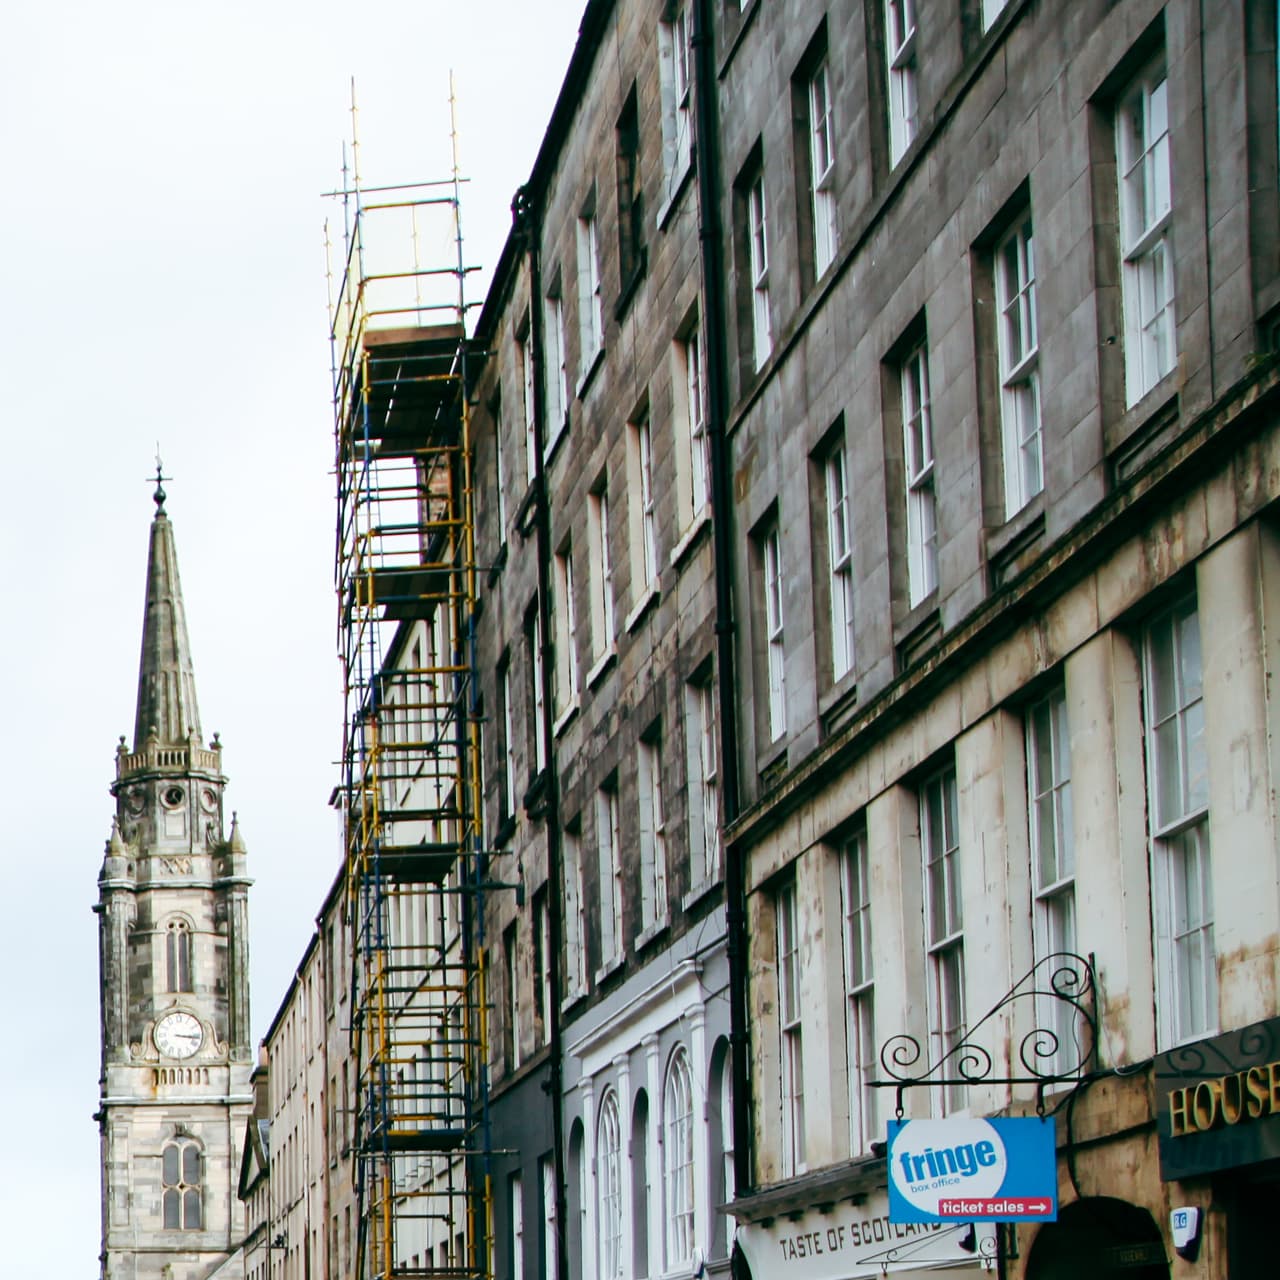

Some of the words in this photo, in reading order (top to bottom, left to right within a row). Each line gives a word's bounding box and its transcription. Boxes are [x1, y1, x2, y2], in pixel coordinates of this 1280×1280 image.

[1167, 1061, 1280, 1138] HOUSE
[900, 1140, 997, 1184] fringe
[910, 1184, 930, 1194] box
[931, 1177, 961, 1190] office
[942, 1199, 984, 1214] ticket
[987, 1199, 1025, 1214] sales
[780, 1231, 823, 1261] TASTE
[827, 1226, 845, 1252] OF
